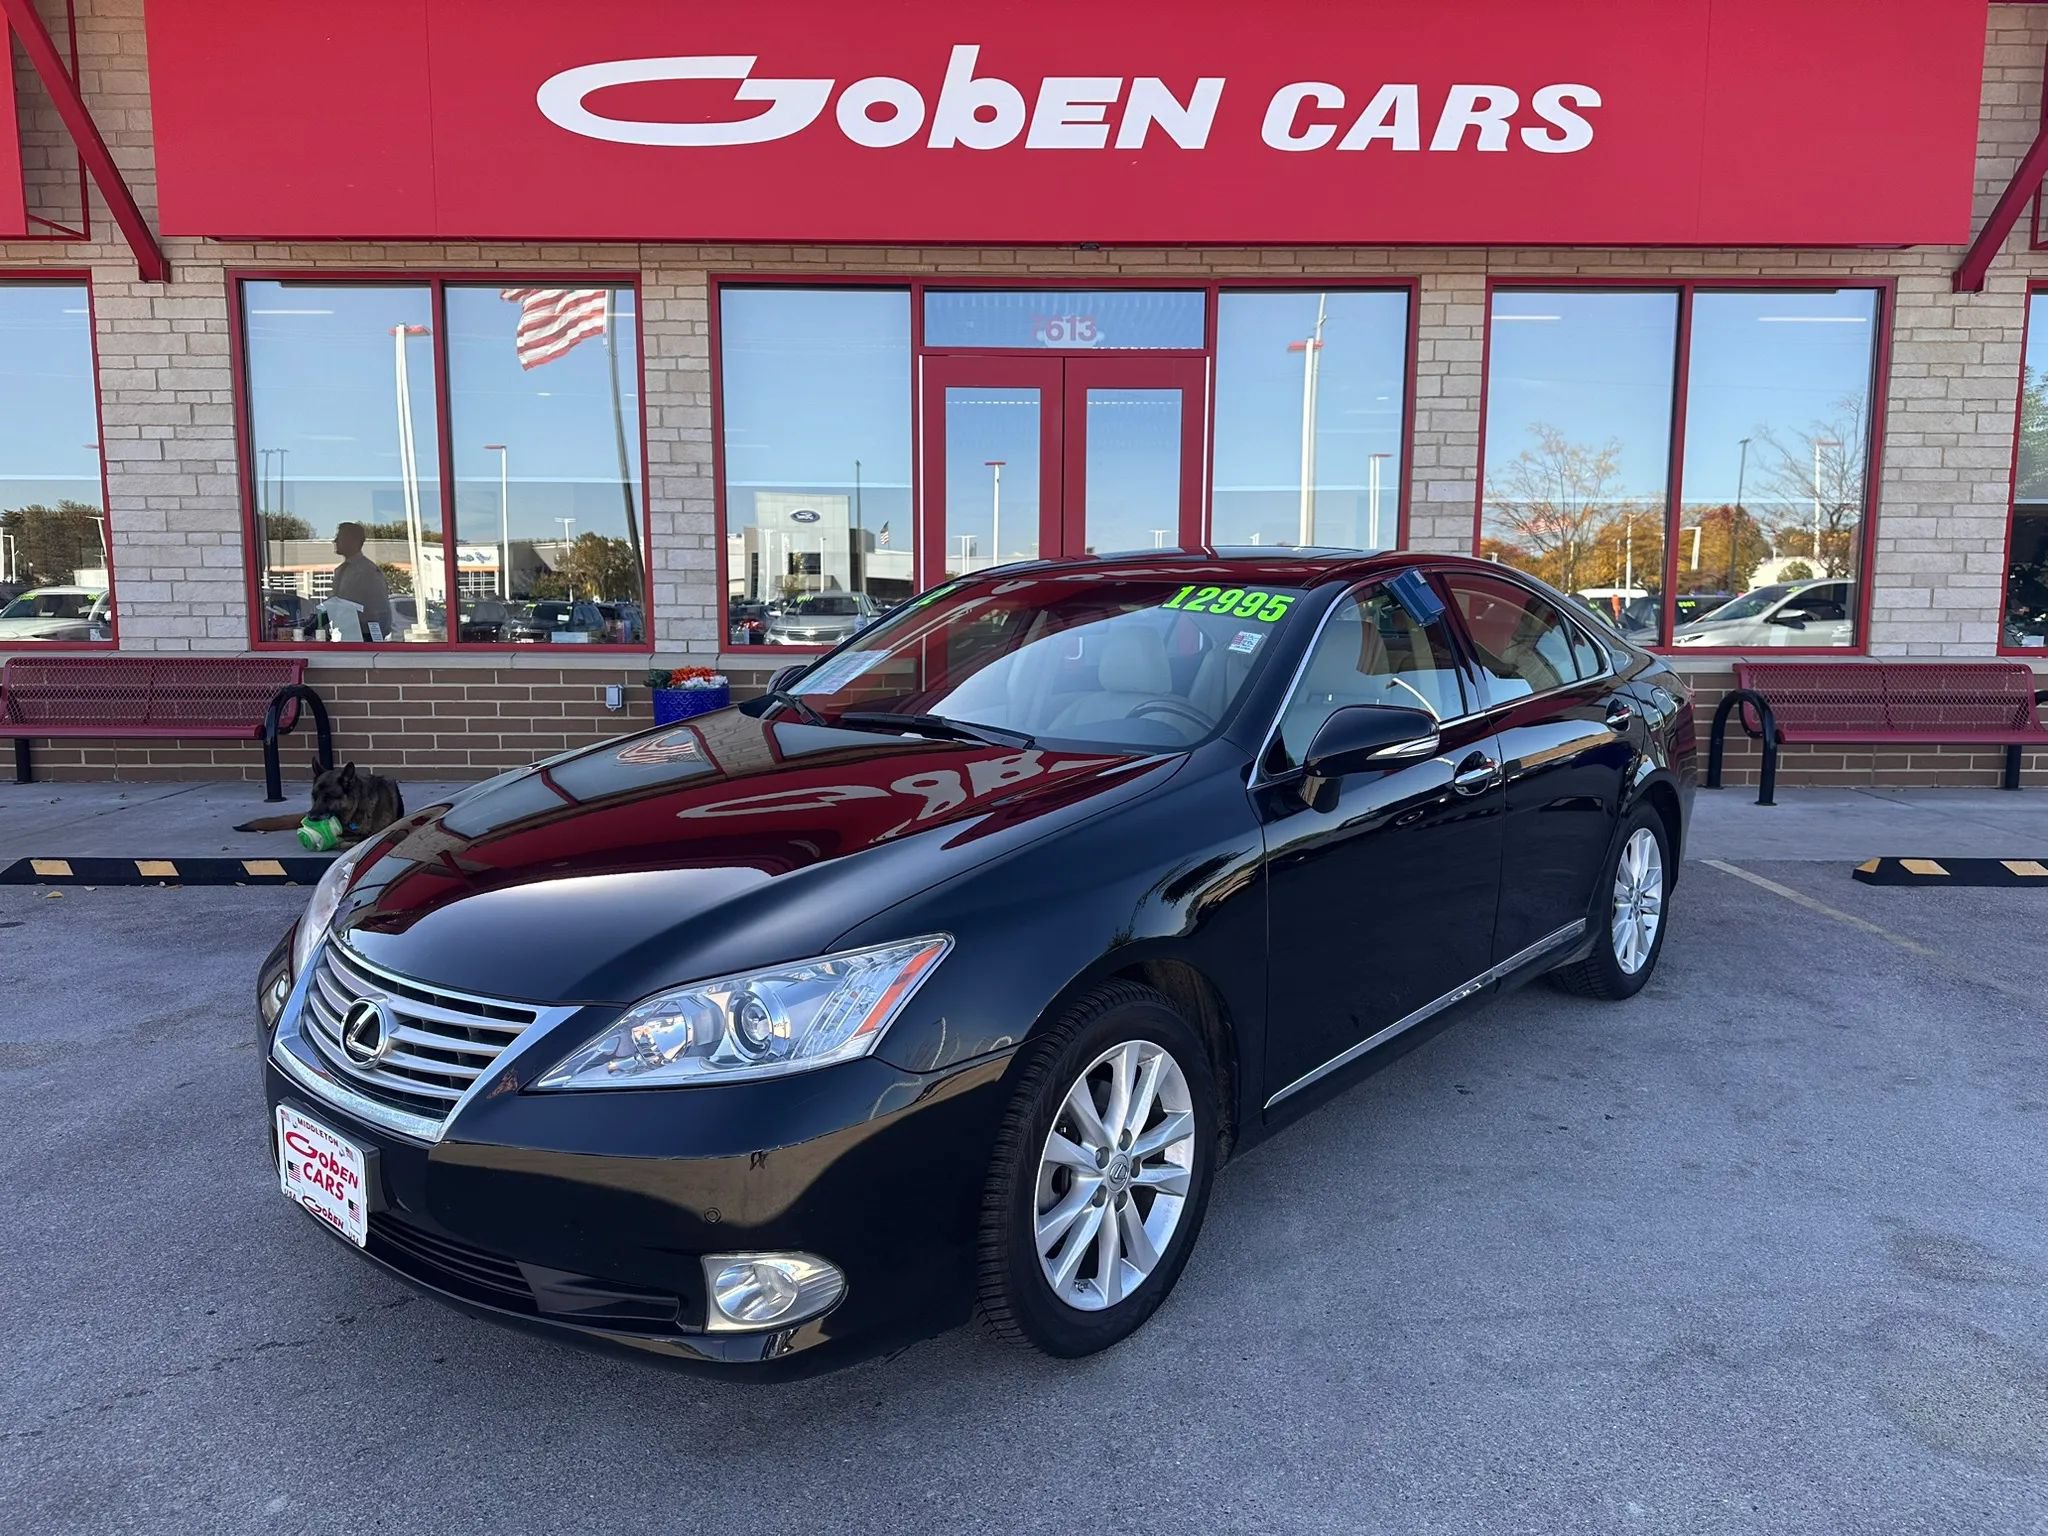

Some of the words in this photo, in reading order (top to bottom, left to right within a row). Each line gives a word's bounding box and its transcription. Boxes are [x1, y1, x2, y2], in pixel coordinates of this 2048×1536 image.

[1262, 82, 1601, 153] CARS
[1161, 585, 1296, 622] 12995
[297, 1117, 339, 1146] MIDDLETON
[303, 1162, 344, 1201] CARS
